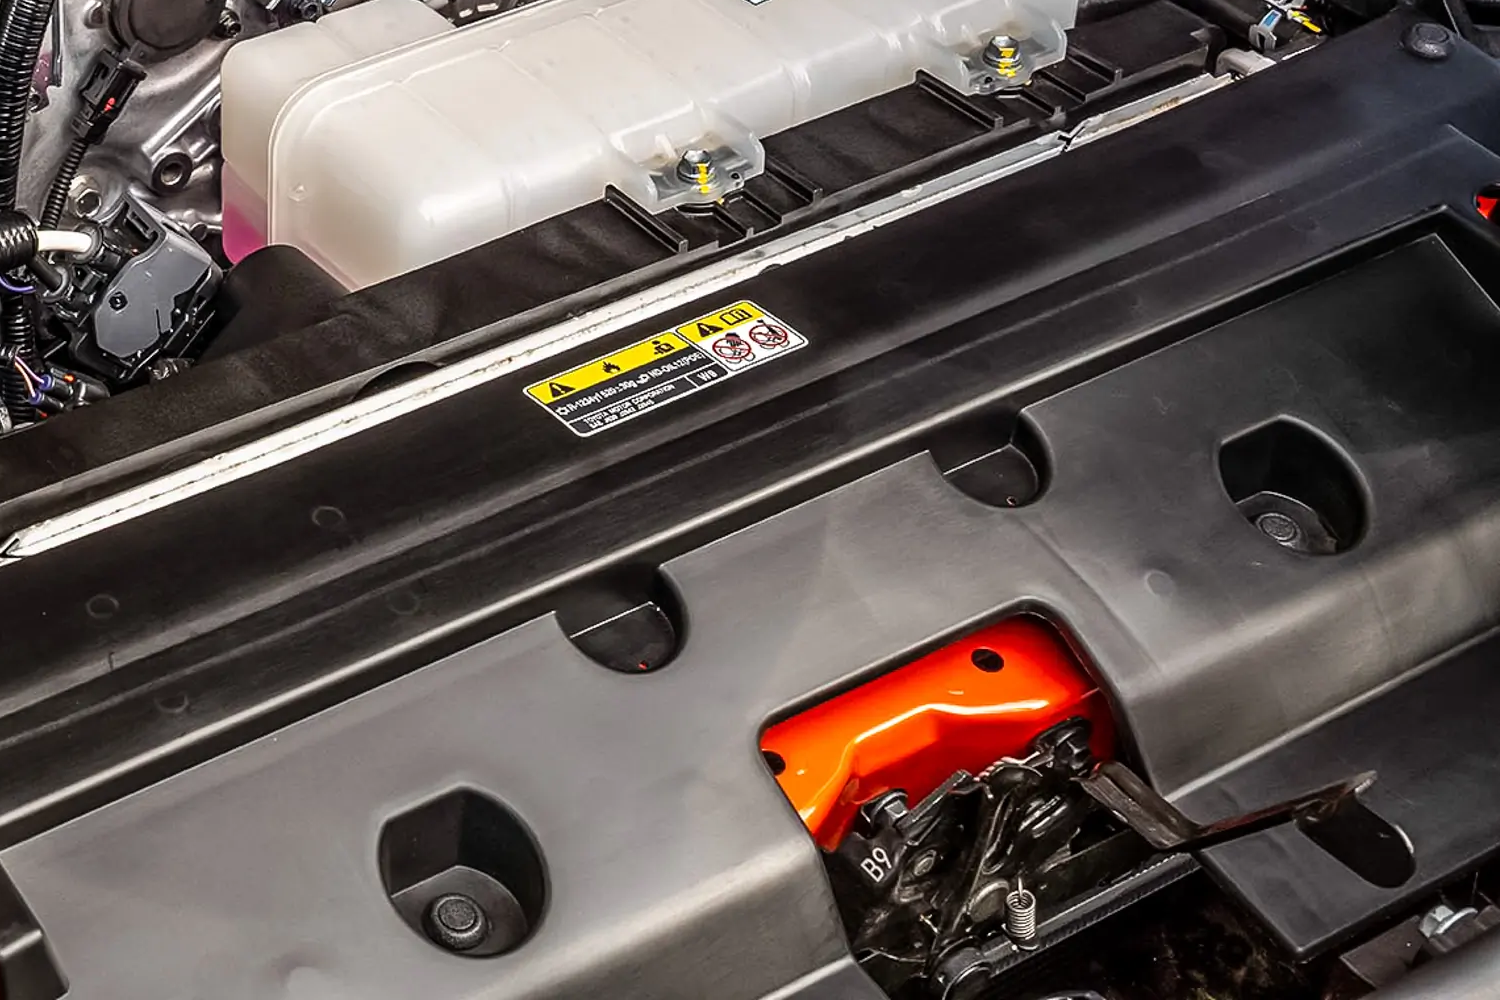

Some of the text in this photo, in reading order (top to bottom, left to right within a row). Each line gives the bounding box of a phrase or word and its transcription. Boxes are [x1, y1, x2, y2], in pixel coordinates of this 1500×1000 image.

[583, 383, 676, 425] TOYOTA MOTOR CORPORATION
[860, 846, 893, 883] B9
